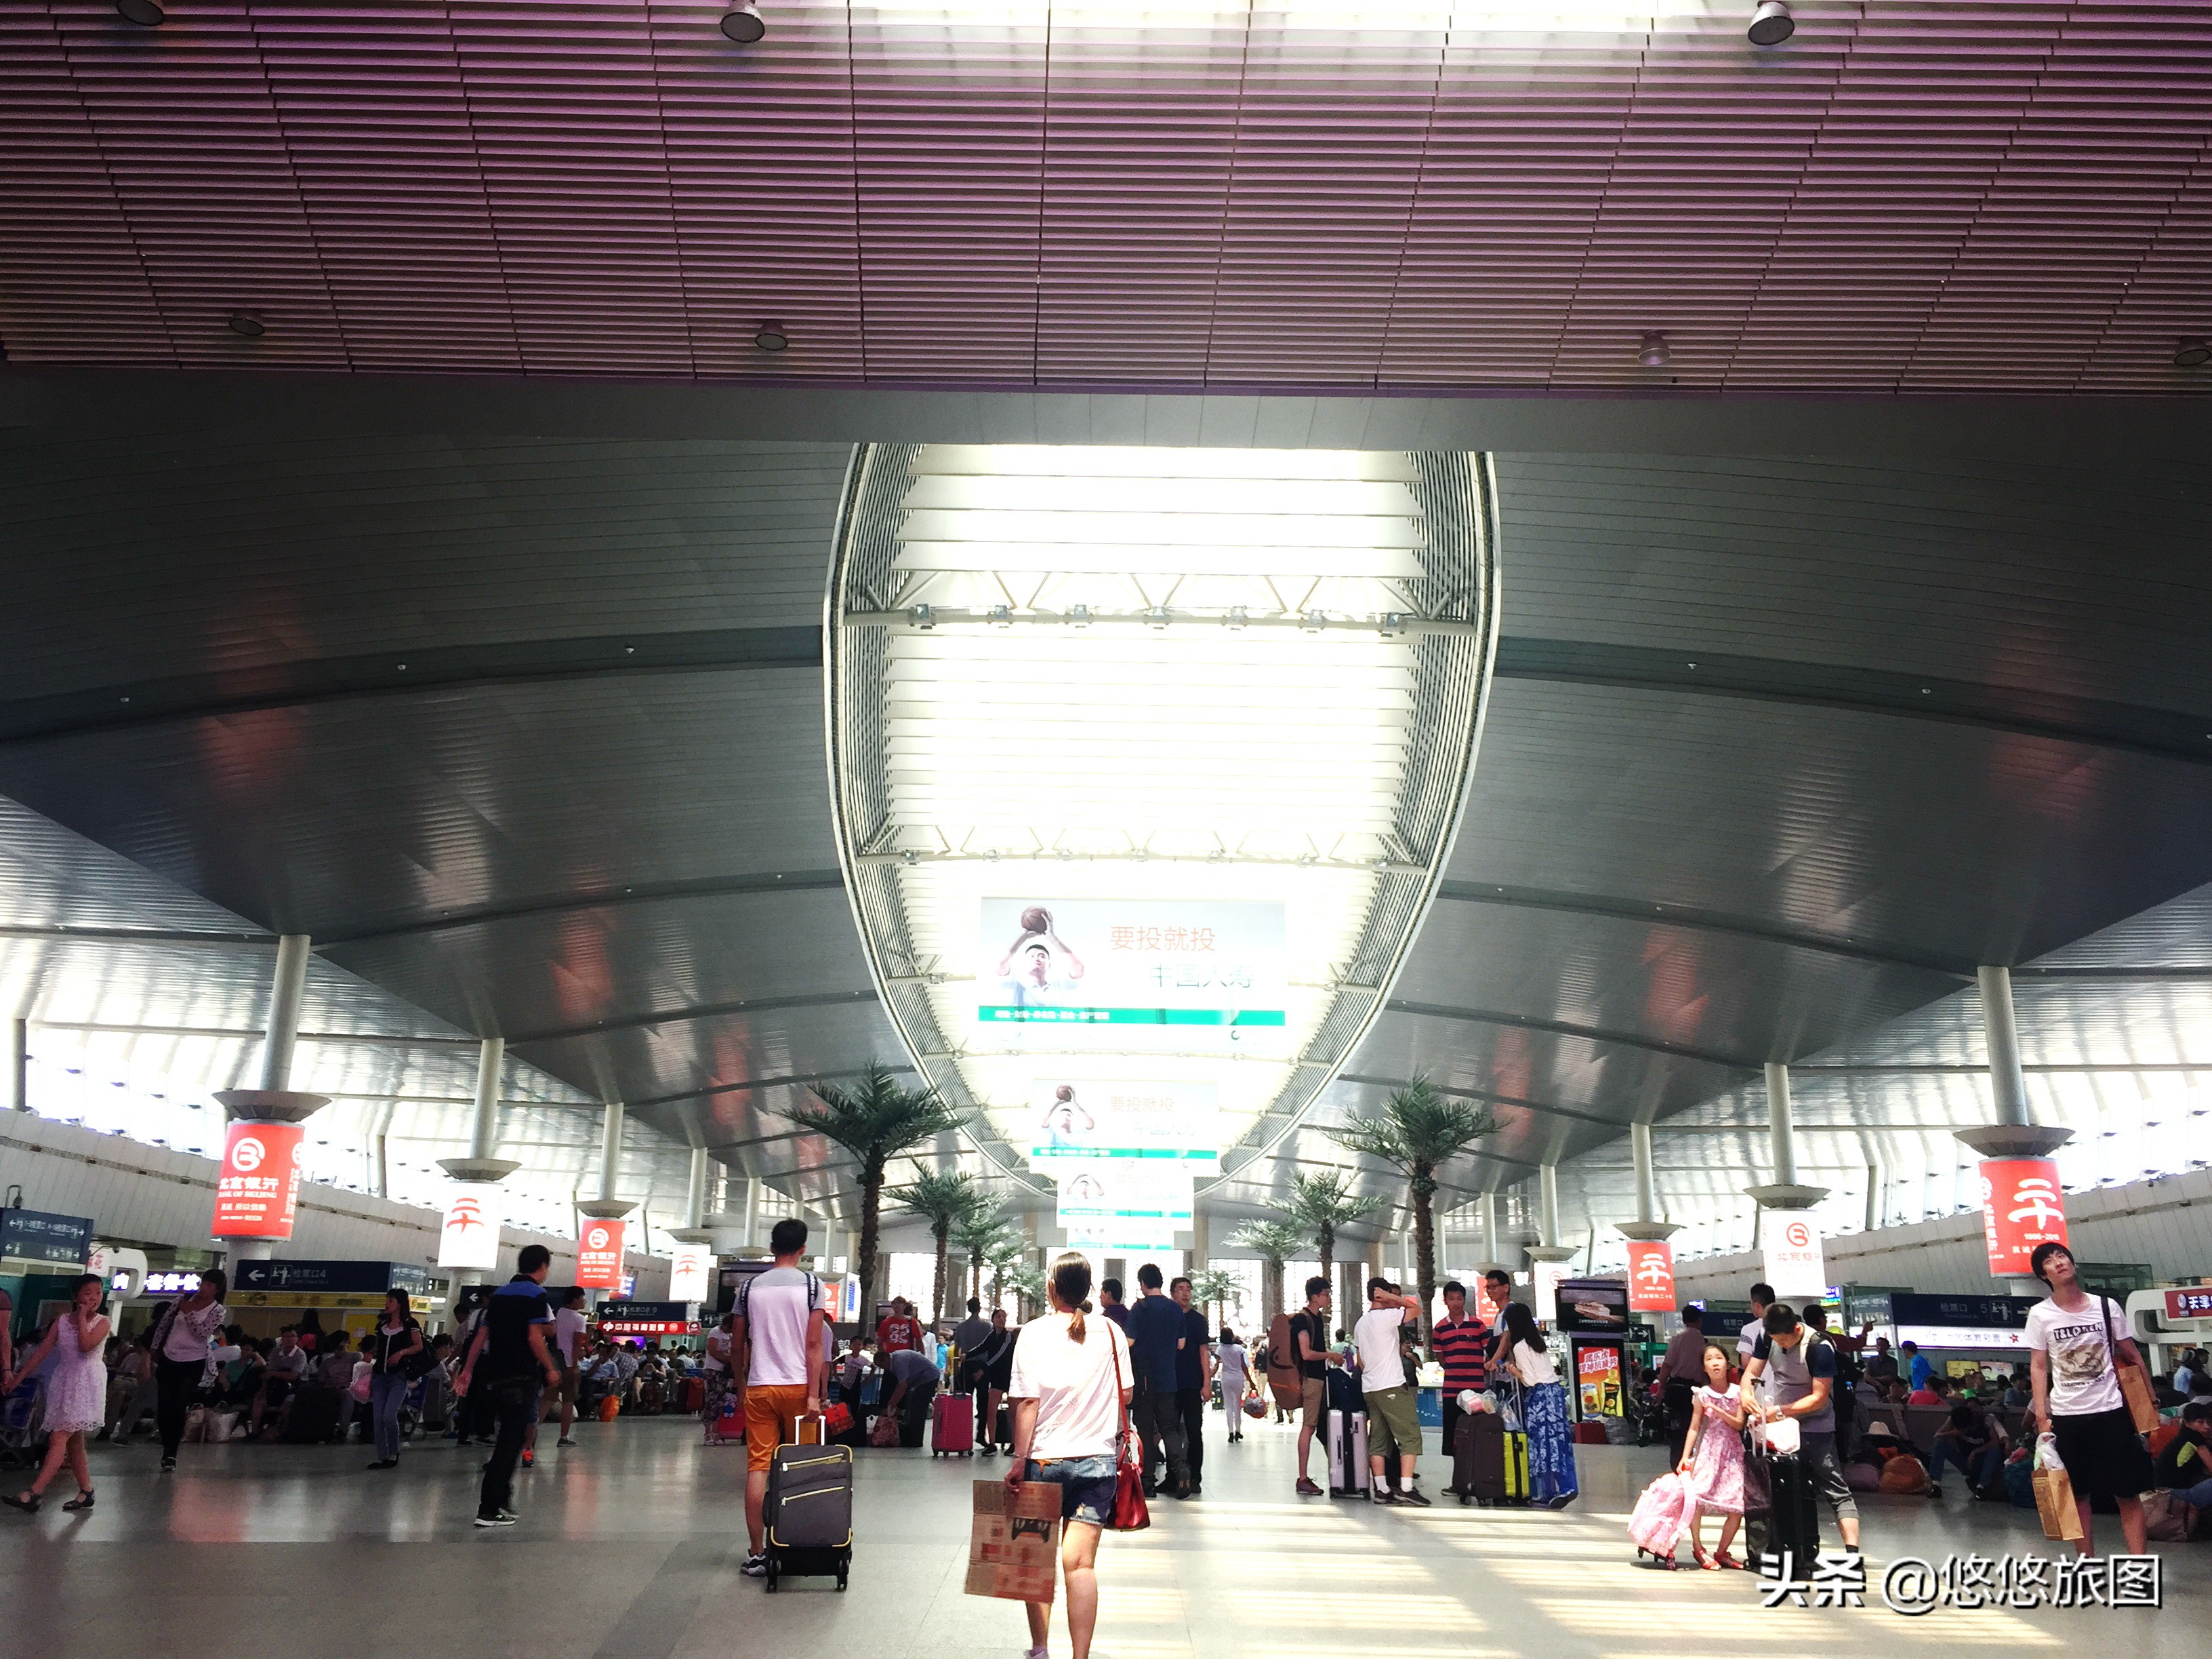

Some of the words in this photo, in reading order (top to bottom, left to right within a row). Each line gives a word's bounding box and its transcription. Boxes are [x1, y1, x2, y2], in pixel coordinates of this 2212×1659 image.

[1109, 926, 1216, 951] 要投就投
[1151, 963, 1255, 988] 中国人寿
